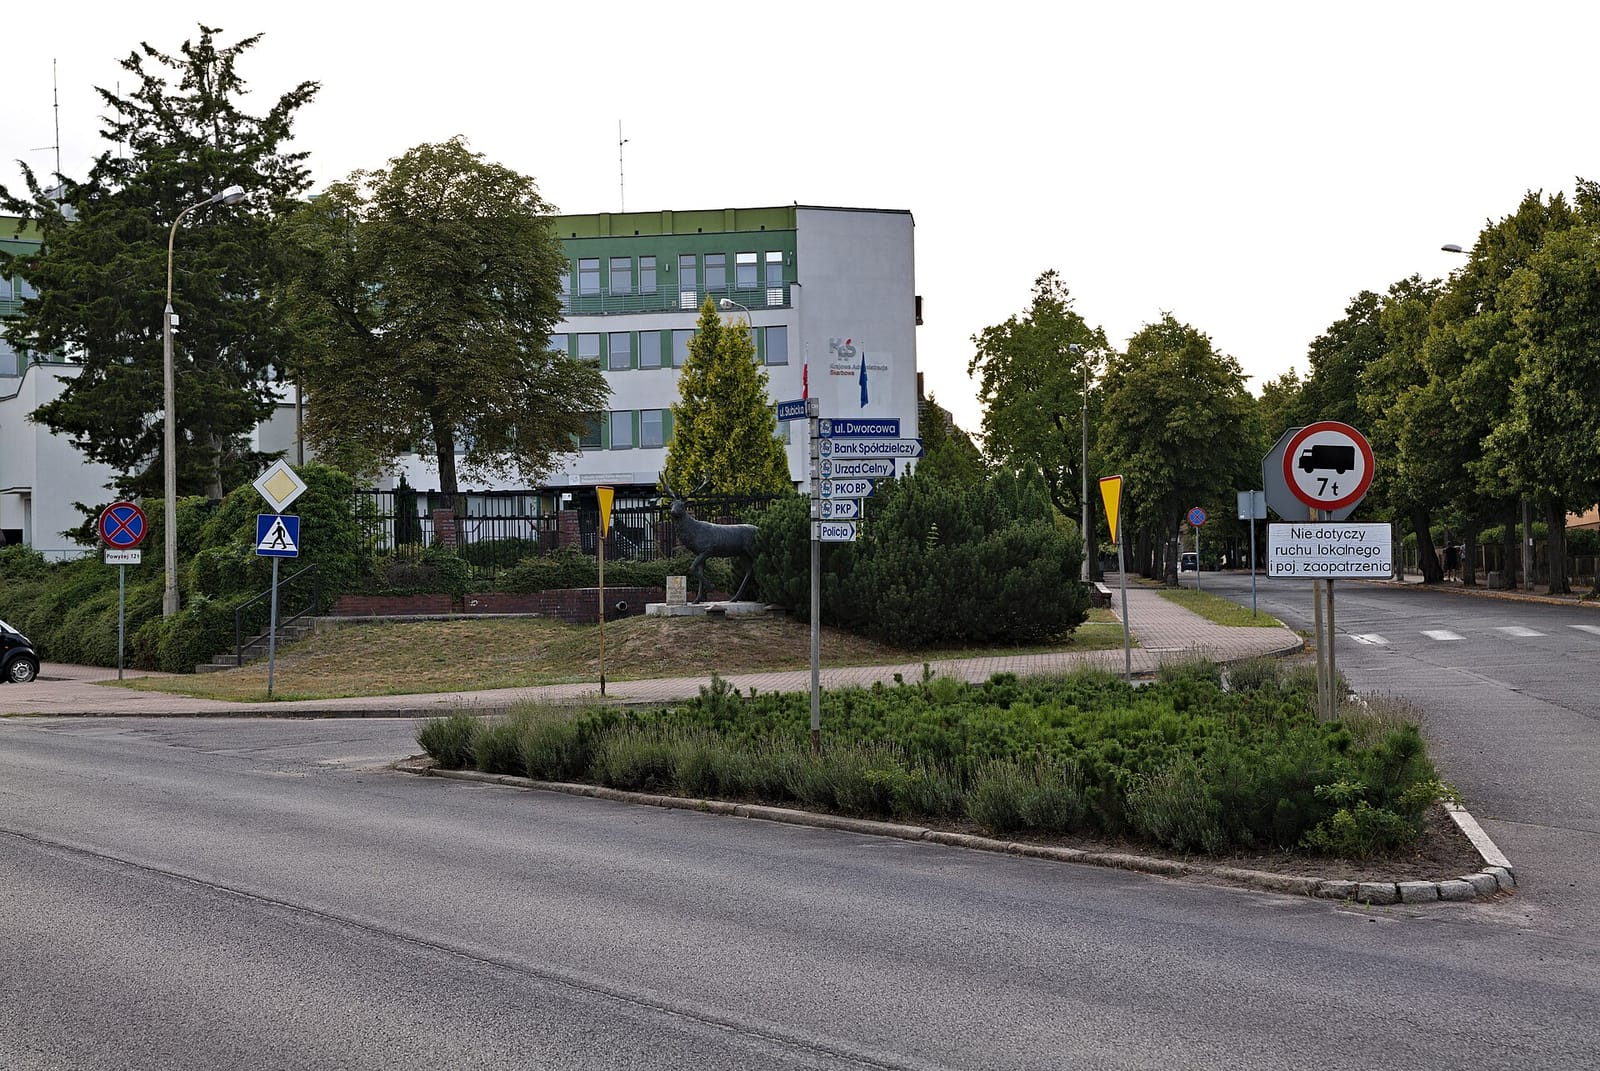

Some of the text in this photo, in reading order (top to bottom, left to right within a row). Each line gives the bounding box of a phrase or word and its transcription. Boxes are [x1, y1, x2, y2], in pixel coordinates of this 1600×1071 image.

[834, 423, 896, 433] ul. Dworcowa
[834, 443, 915, 455] Bank Spółdzielczy
[835, 463, 888, 476] Urząd Celny
[835, 483, 866, 494] PKO BP
[1317, 477, 1339, 496] 7 t
[835, 504, 851, 514] PKP
[822, 527, 848, 538] Policja
[1291, 527, 1366, 542] Nie dotyczy
[1275, 544, 1380, 558] ruchu lokalnego
[1270, 560, 1391, 574] i poj. zaopatrzenia
